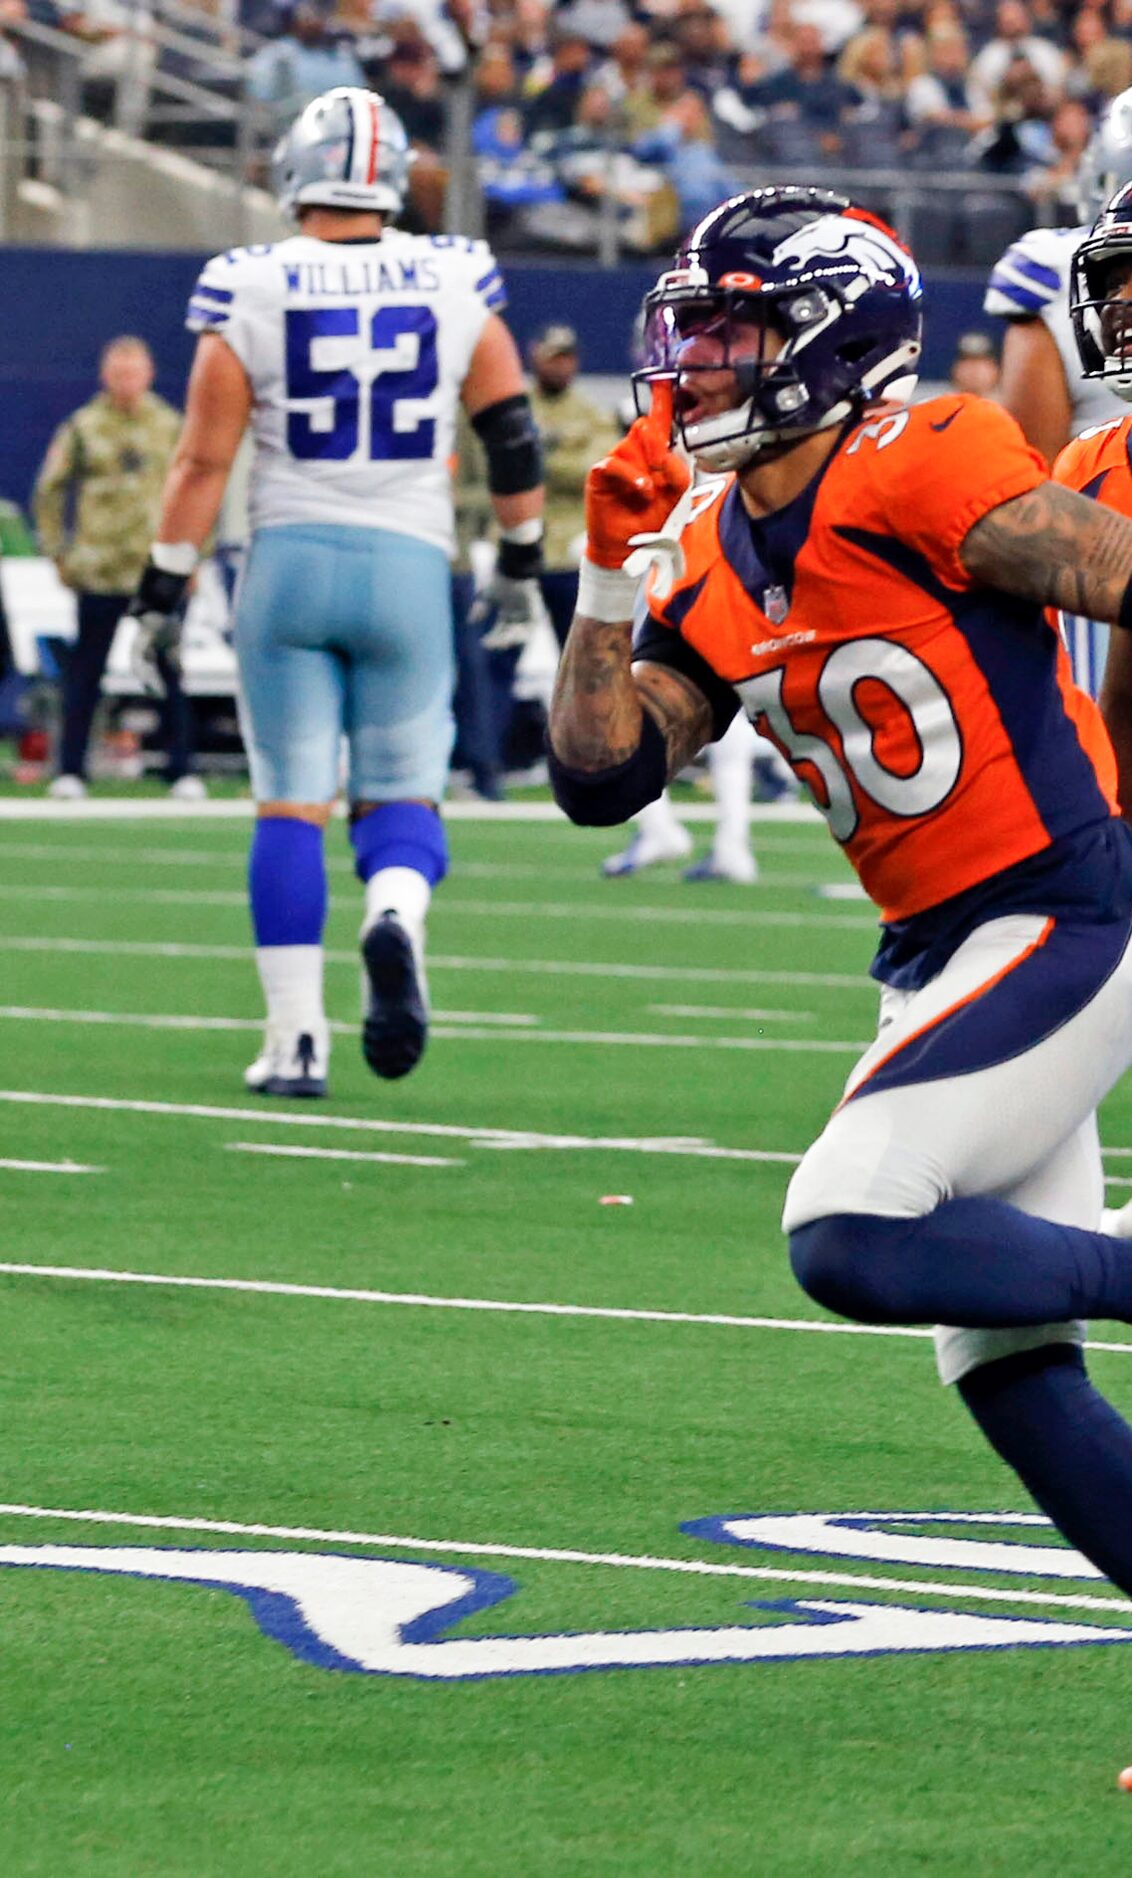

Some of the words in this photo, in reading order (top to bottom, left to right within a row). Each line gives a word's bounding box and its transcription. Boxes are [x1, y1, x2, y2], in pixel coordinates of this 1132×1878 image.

[282, 258, 439, 295] WILLIAMS
[285, 306, 438, 460] 52
[733, 636, 963, 842] 30
